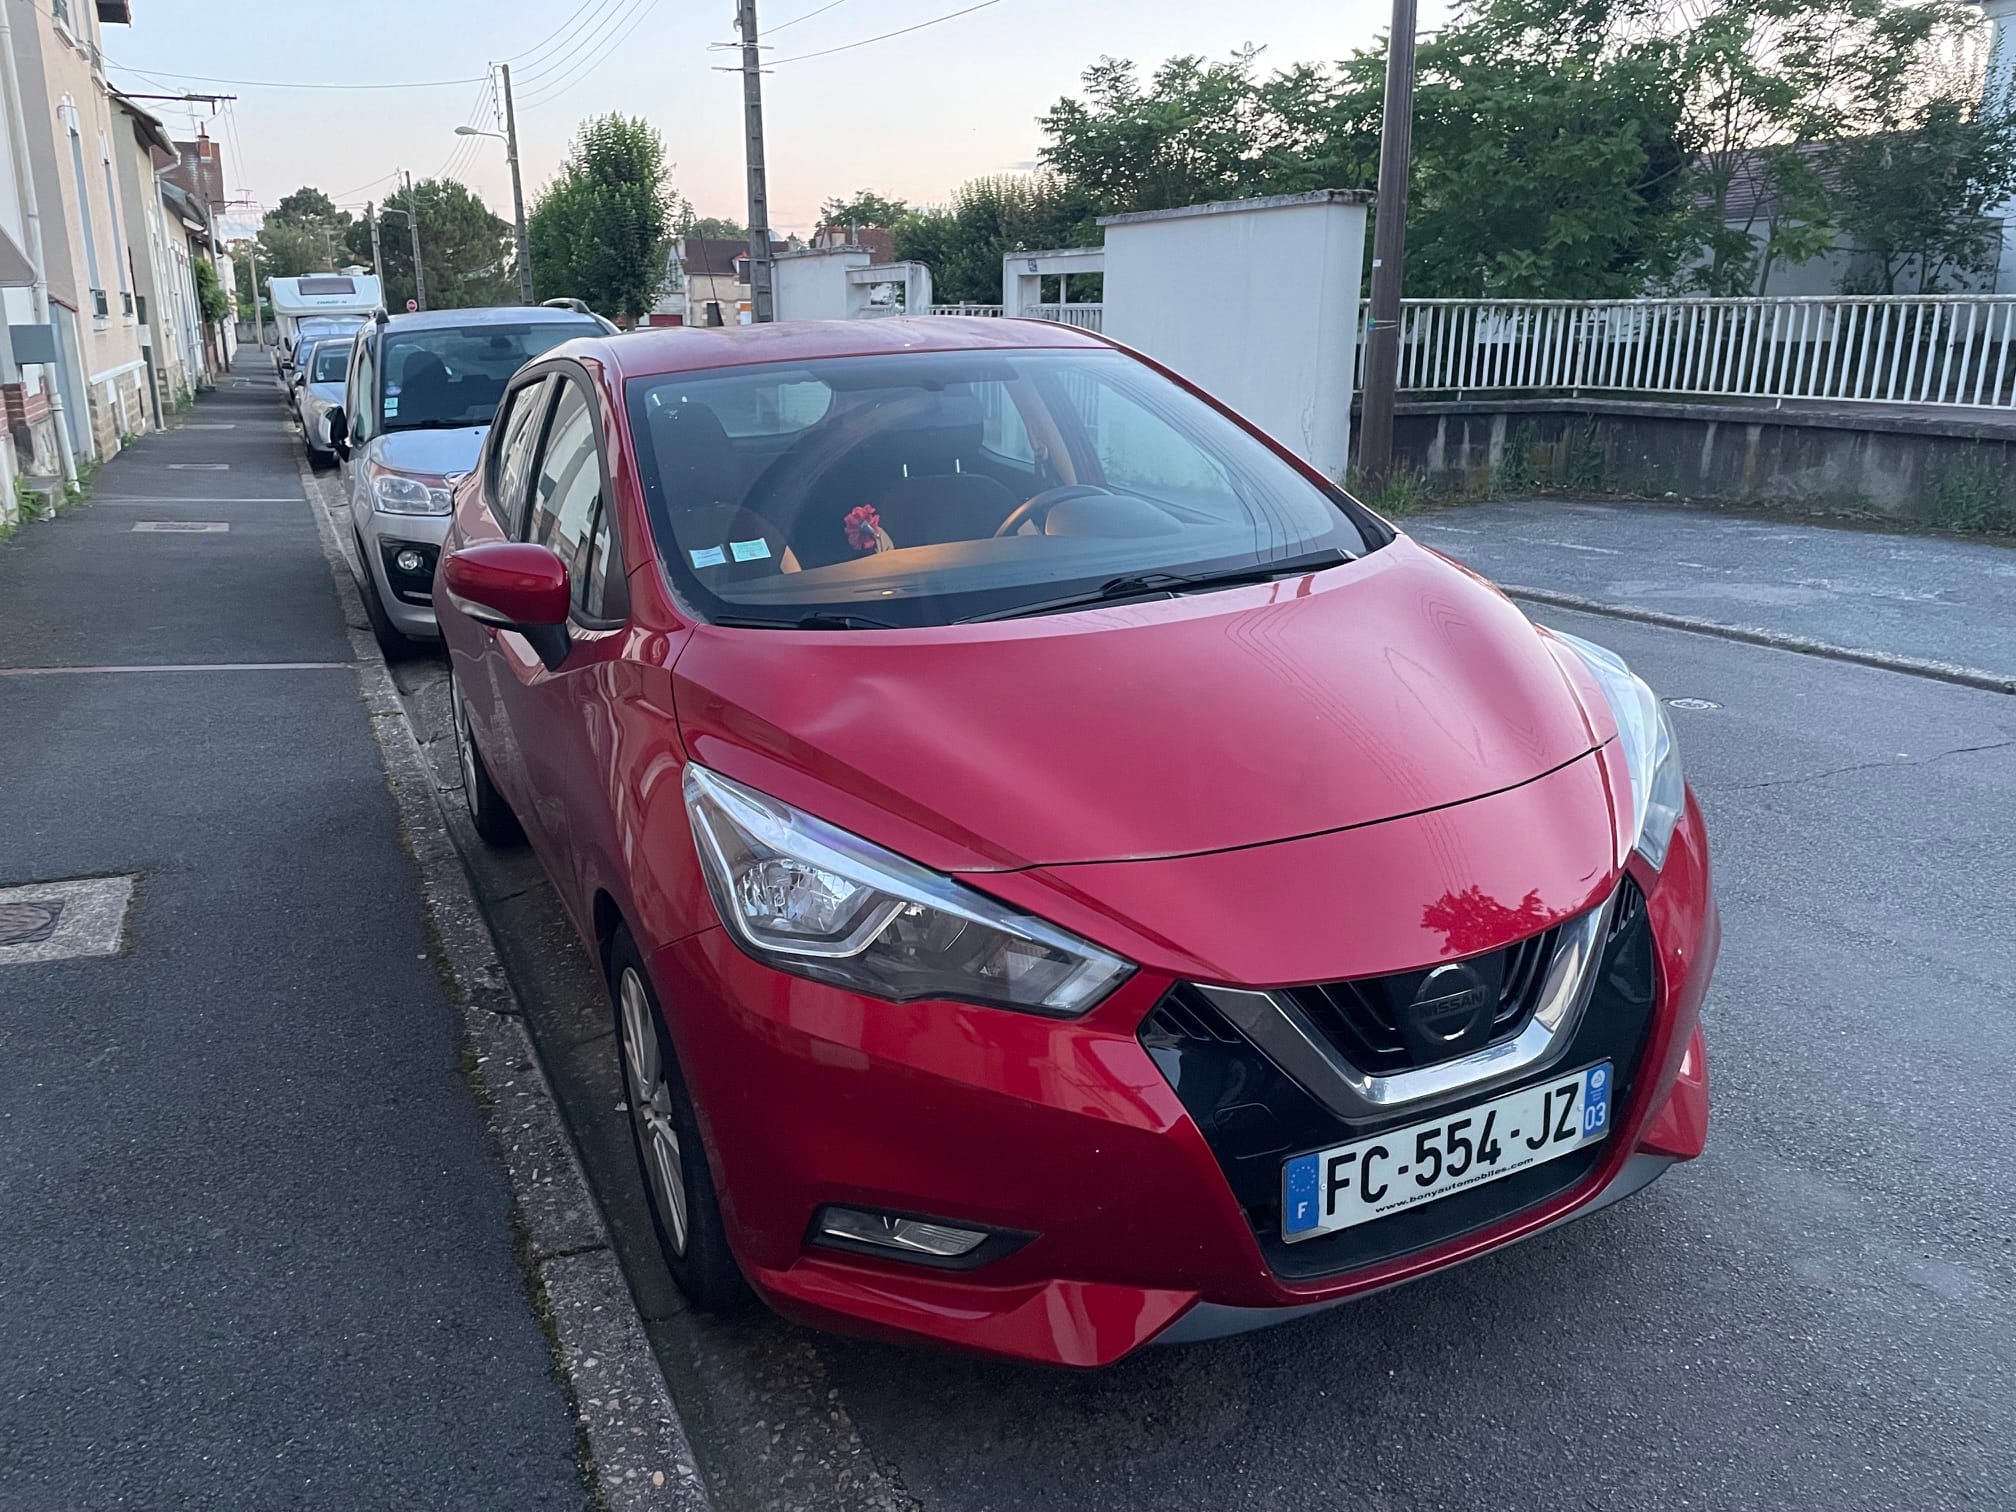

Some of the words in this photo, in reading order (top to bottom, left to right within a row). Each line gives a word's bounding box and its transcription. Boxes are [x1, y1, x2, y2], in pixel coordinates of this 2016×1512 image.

[1418, 991, 1482, 1017] NISSAN
[1297, 1201, 1308, 1219] F
[1326, 1081, 1580, 1216] FC-554-JZ
[1585, 1102, 1606, 1130] 03
[1375, 1157, 1534, 1213] www.bonyautomobiles.com
